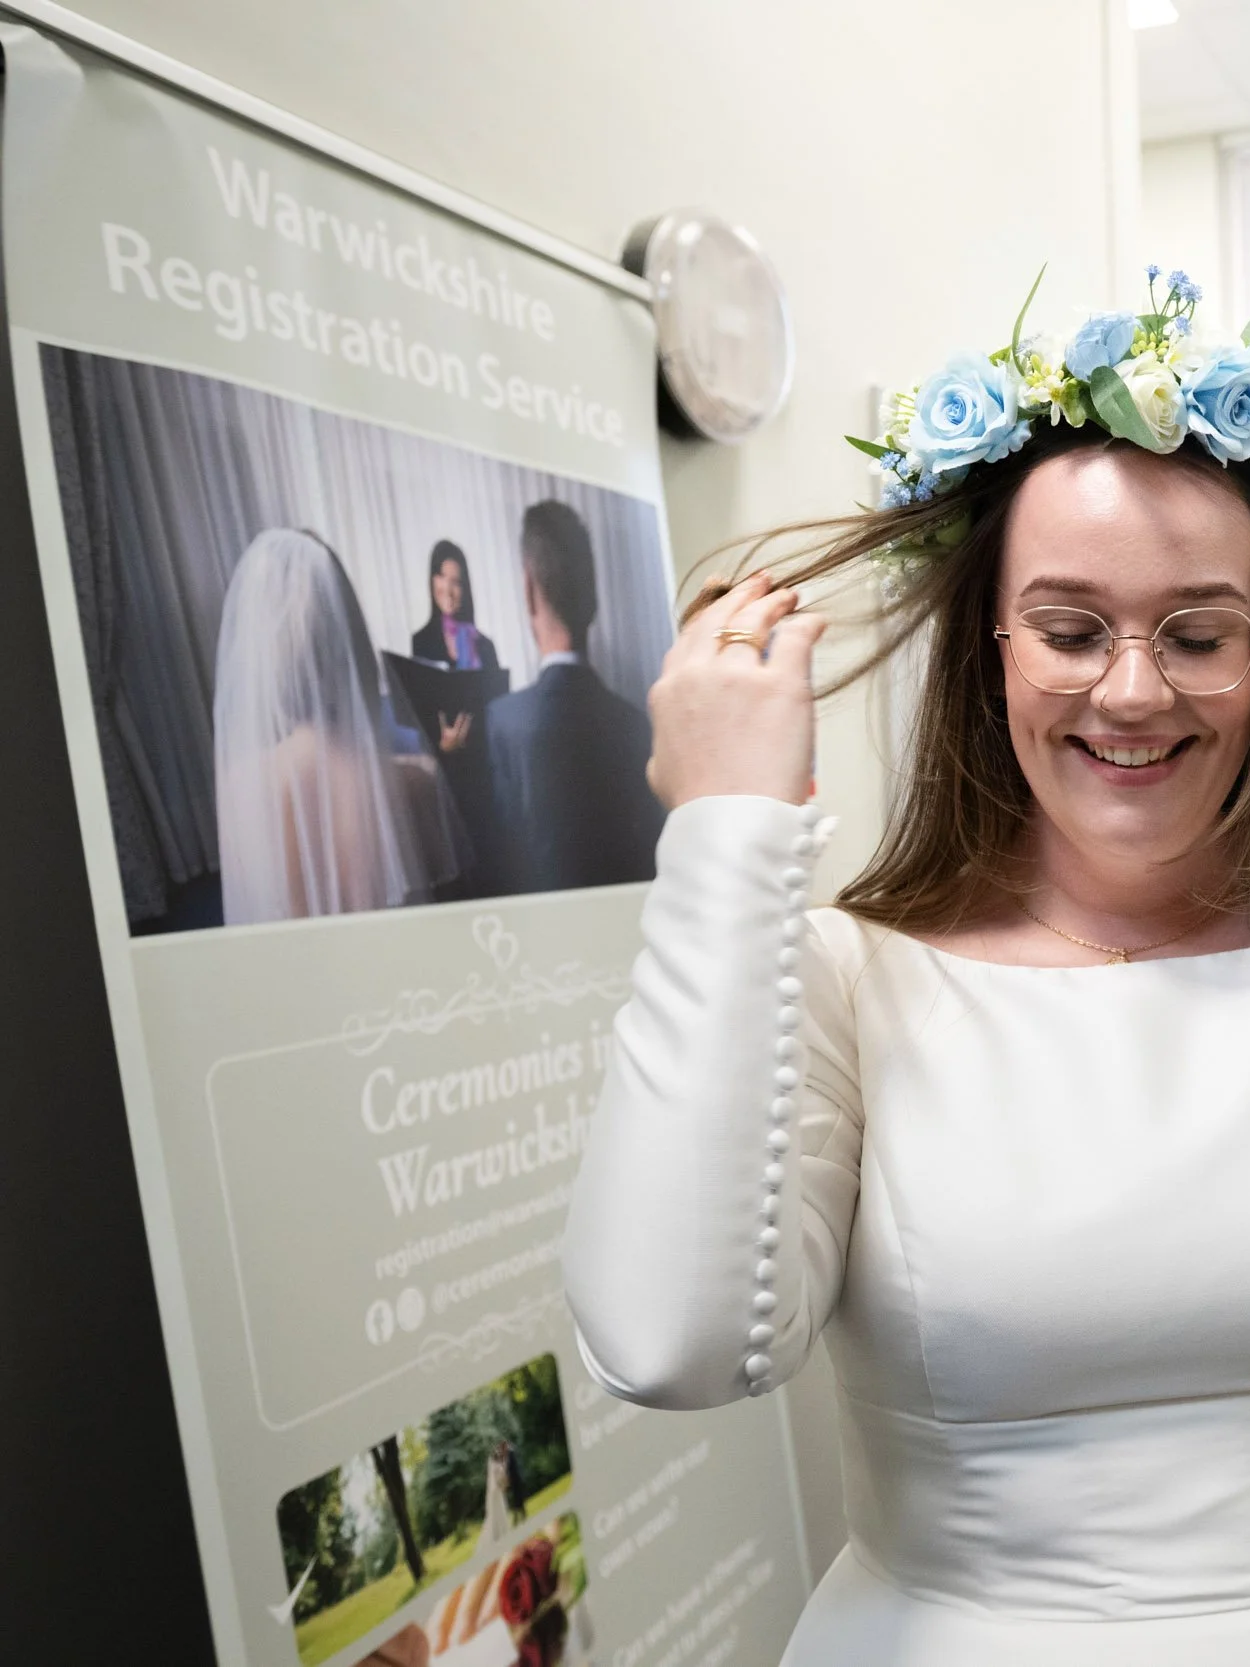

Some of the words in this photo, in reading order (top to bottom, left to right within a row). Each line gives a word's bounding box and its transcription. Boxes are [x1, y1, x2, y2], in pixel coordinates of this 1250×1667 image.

[101, 221, 470, 399] Registration
[478, 354, 625, 447] Service
[208, 146, 556, 341] Warwickshire
[361, 1031, 583, 1135] Ceremonies
